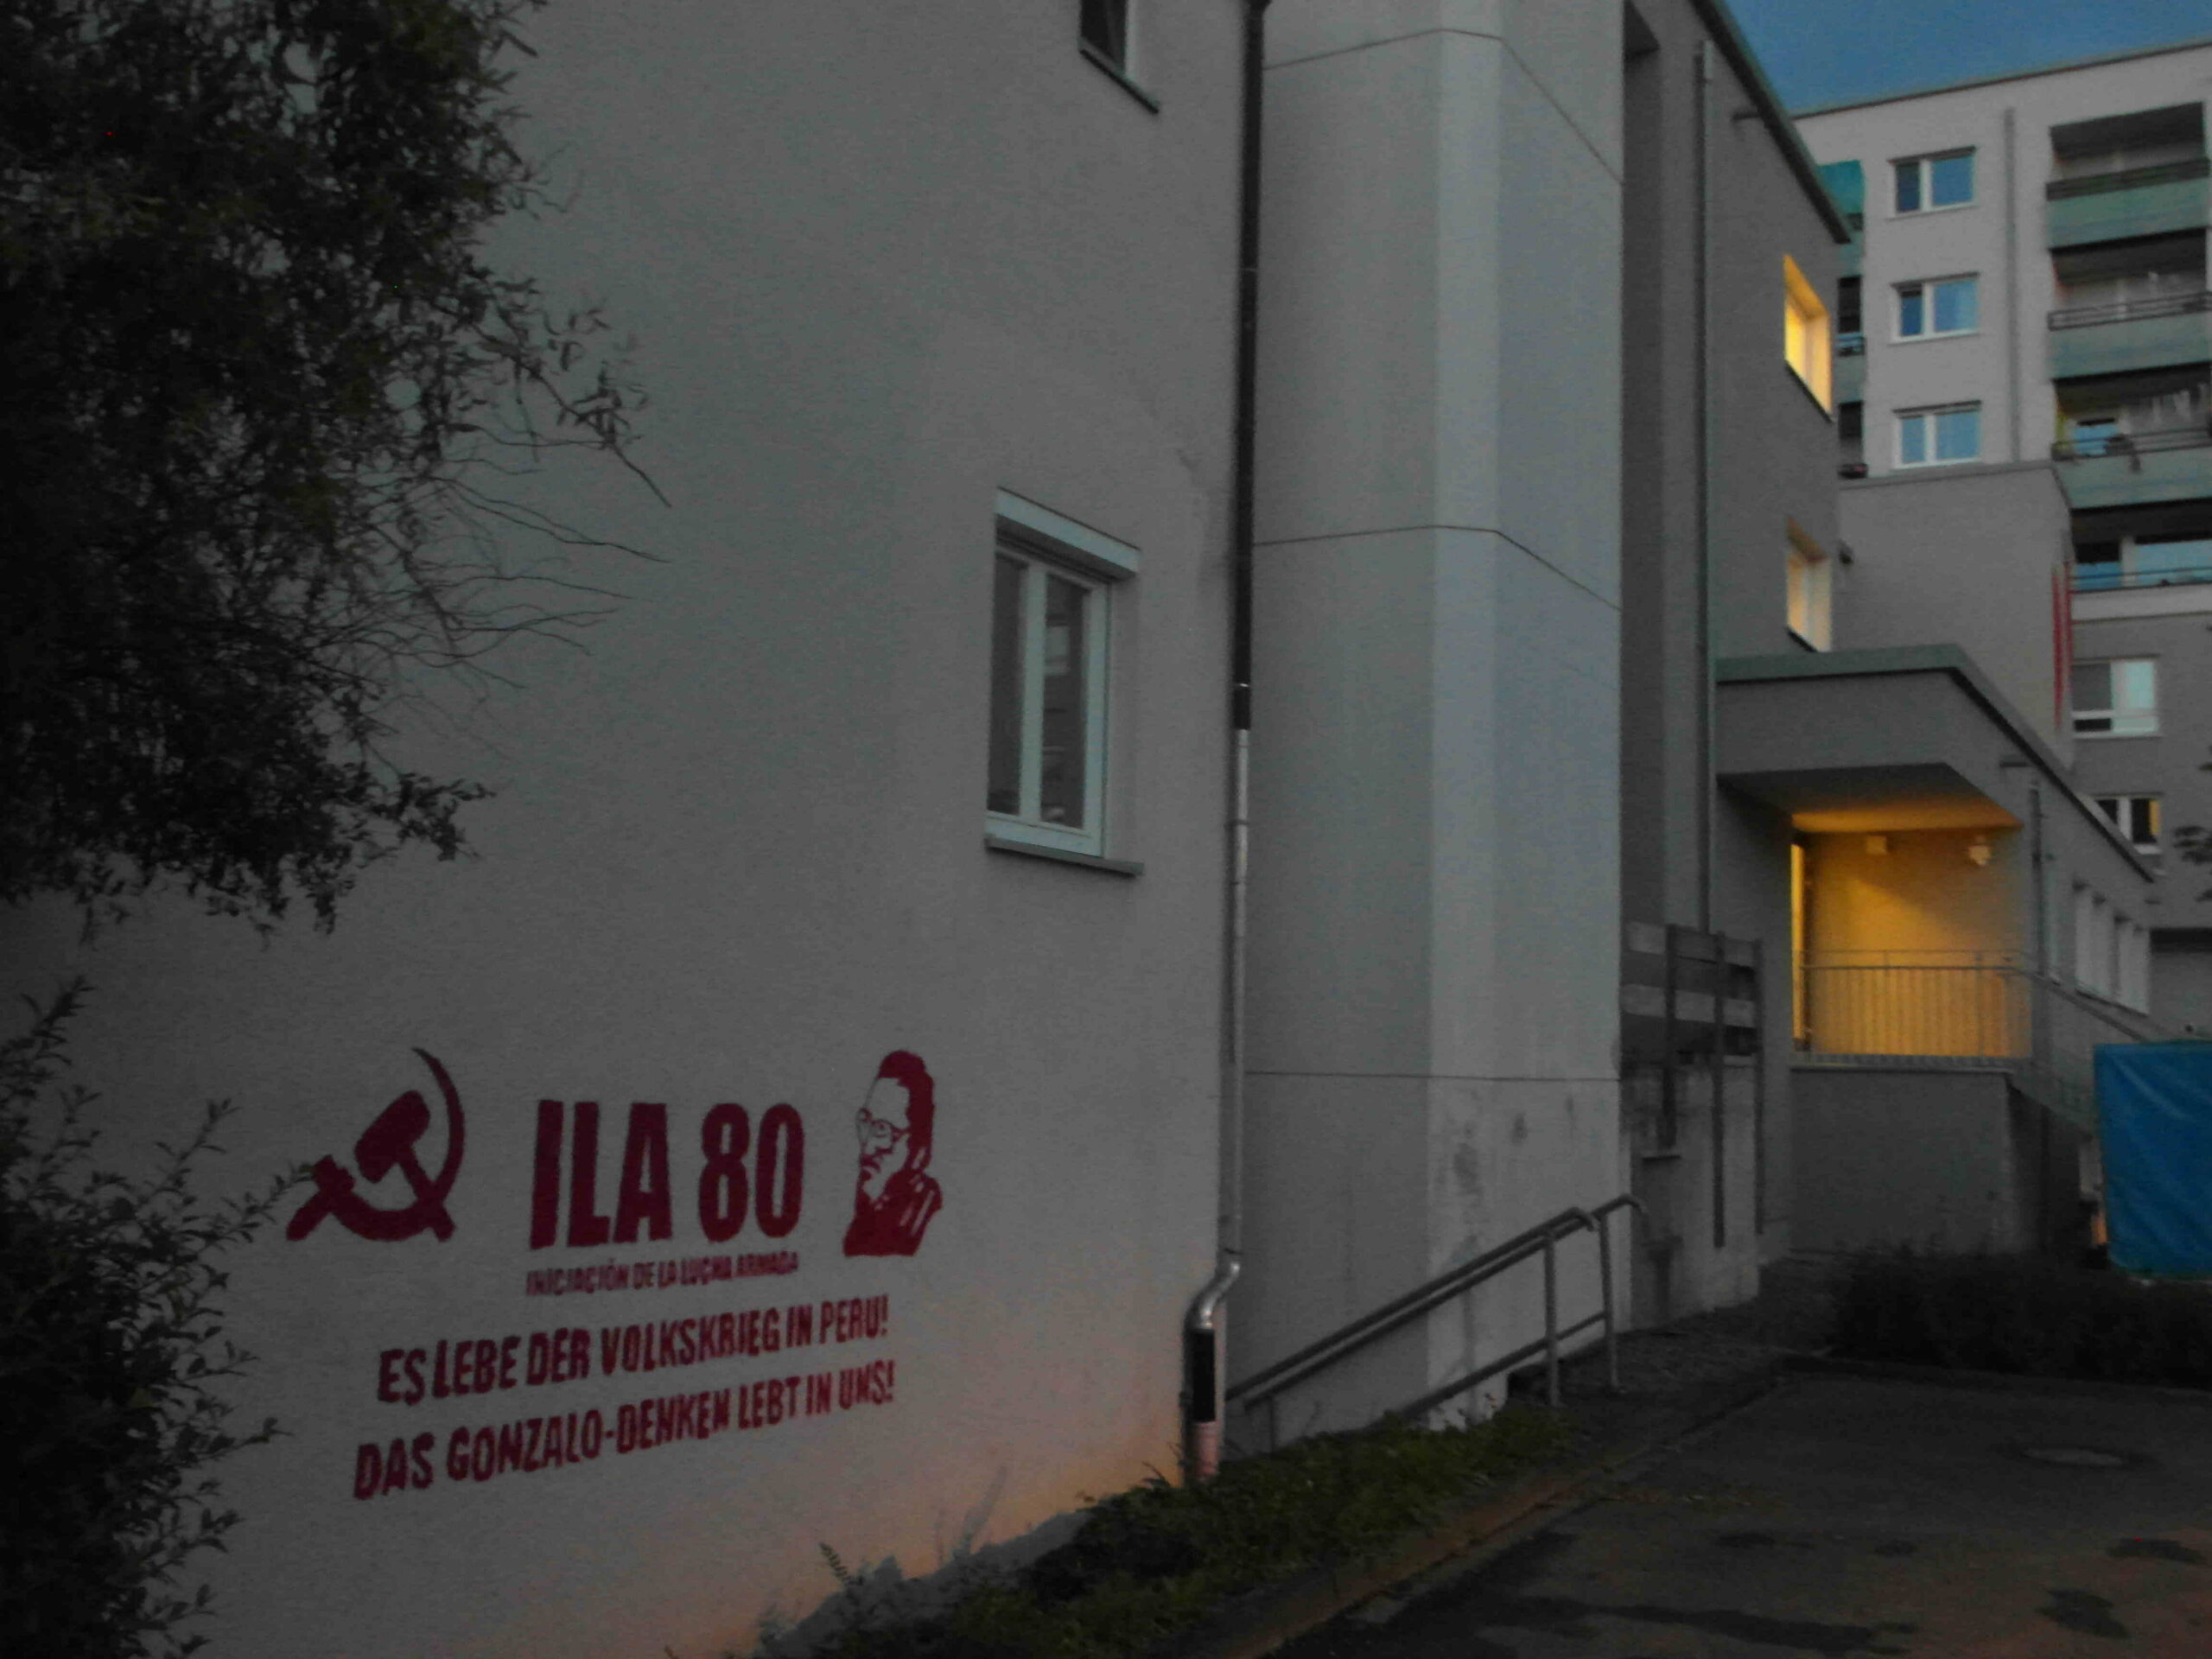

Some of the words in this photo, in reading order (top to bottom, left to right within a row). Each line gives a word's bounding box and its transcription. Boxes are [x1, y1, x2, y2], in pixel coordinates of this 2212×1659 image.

[529, 1099, 673, 1249] ILA
[697, 1103, 805, 1243] 80
[633, 1262, 654, 1289] DE
[658, 1260, 677, 1289] LA
[377, 1348, 428, 1406] ES
[433, 1336, 521, 1399] LEBE
[526, 1327, 591, 1386] DER
[601, 1307, 781, 1376] VOLKSKRIEG
[786, 1304, 813, 1348] IN
[819, 1294, 889, 1344] PERU!
[353, 1431, 435, 1500] DAS
[447, 1389, 731, 1483] GONZALO-DENKEN
[738, 1376, 801, 1431] LEBT
[806, 1372, 832, 1417] IN
[838, 1359, 895, 1411] UNS!
